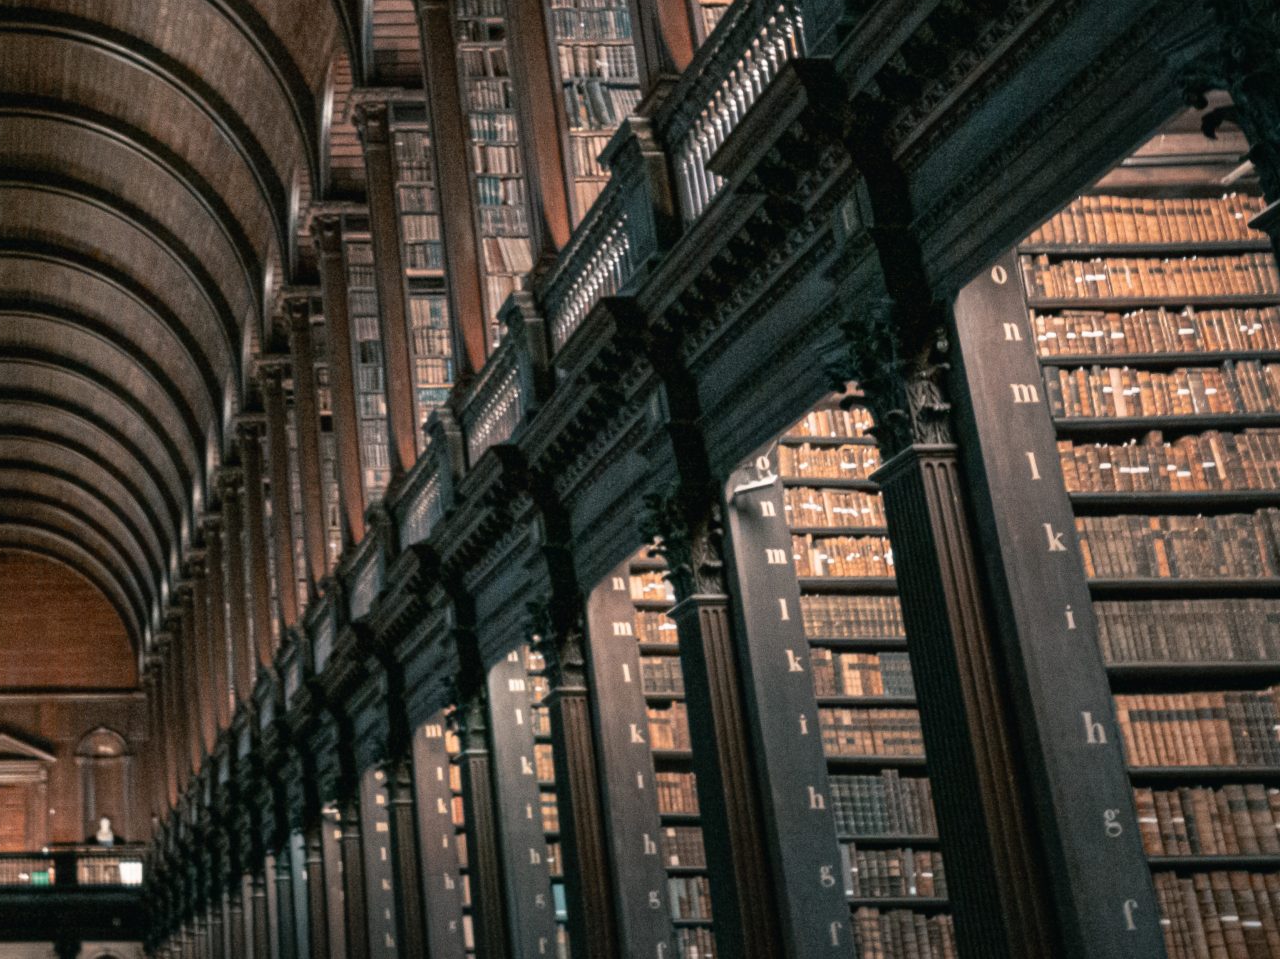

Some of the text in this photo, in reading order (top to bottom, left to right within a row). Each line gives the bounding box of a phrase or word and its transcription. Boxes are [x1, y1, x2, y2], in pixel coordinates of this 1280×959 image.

[991, 265, 1007, 285] o
[1003, 322, 1021, 342] n
[1010, 383, 1039, 404] m
[756, 455, 770, 471] o
[1026, 451, 1040, 480] l
[761, 500, 776, 517] n
[1044, 522, 1065, 552] k
[766, 548, 787, 565] m
[613, 577, 625, 591] n
[778, 597, 790, 621] l
[1065, 604, 1076, 630] i
[613, 621, 632, 636] m
[786, 649, 803, 672] k
[621, 663, 632, 683] l
[630, 723, 644, 743] k
[799, 713, 809, 735] i
[1082, 711, 1106, 744] h
[636, 771, 645, 789] i
[808, 785, 825, 810] h
[1104, 808, 1122, 837] g
[643, 833, 656, 855] h
[820, 865, 835, 887] g
[648, 890, 661, 909] g
[1123, 899, 1137, 931] f
[830, 921, 842, 946] f
